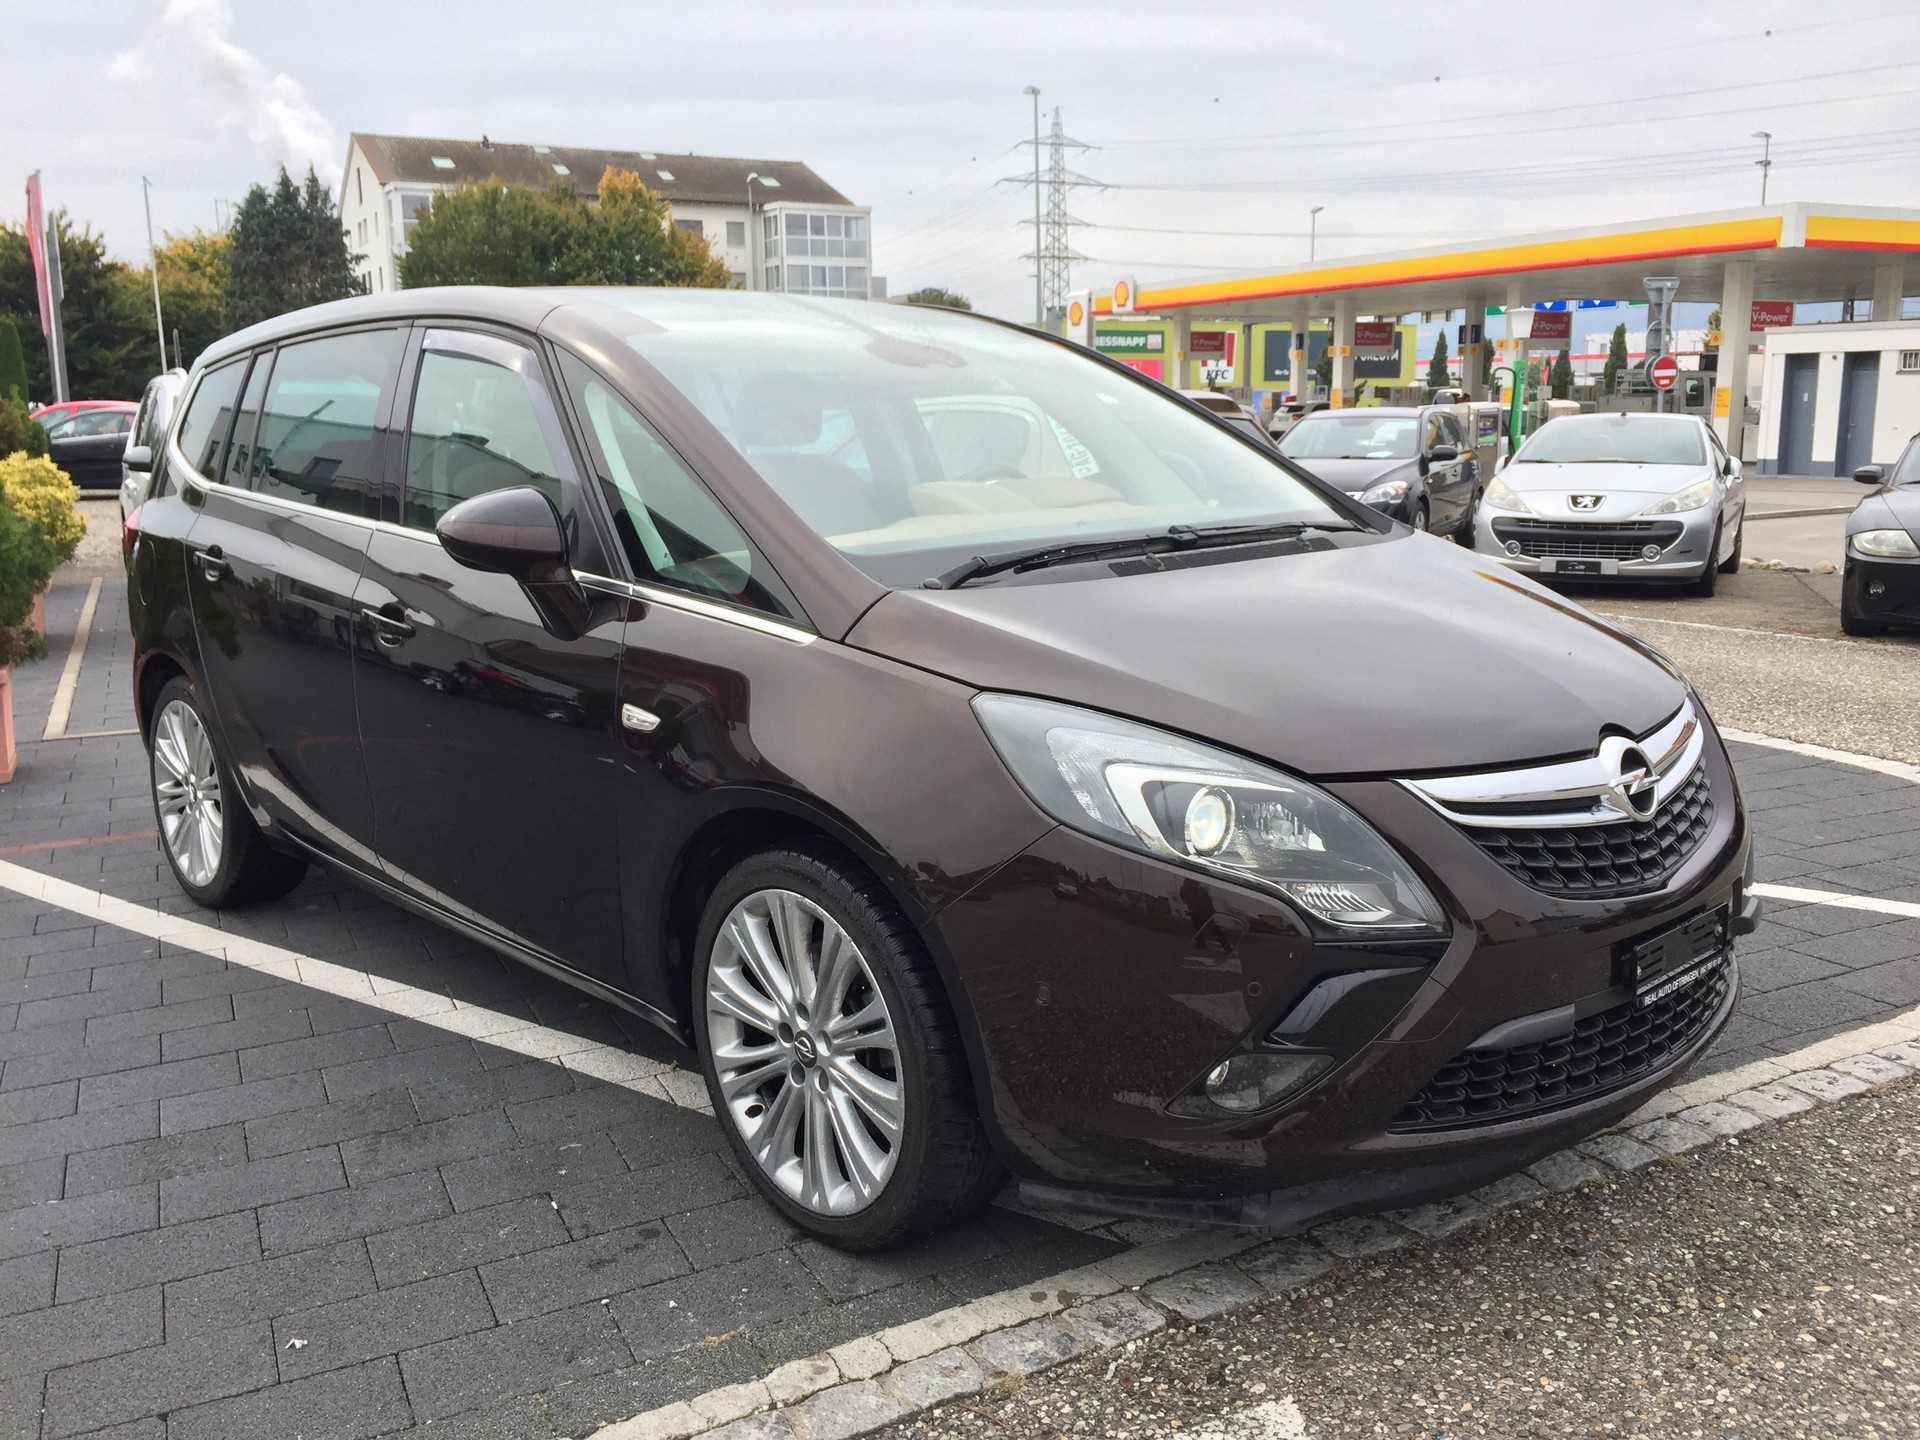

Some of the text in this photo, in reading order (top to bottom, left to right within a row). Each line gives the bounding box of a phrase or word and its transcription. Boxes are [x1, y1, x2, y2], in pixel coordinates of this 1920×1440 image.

[1752, 311, 1788, 321] V-Power
[1095, 336, 1146, 346] RESSNAPF
[1206, 369, 1229, 380] KFC
[1644, 992, 1658, 1006] REAL
[1658, 984, 1671, 998] AUTO
